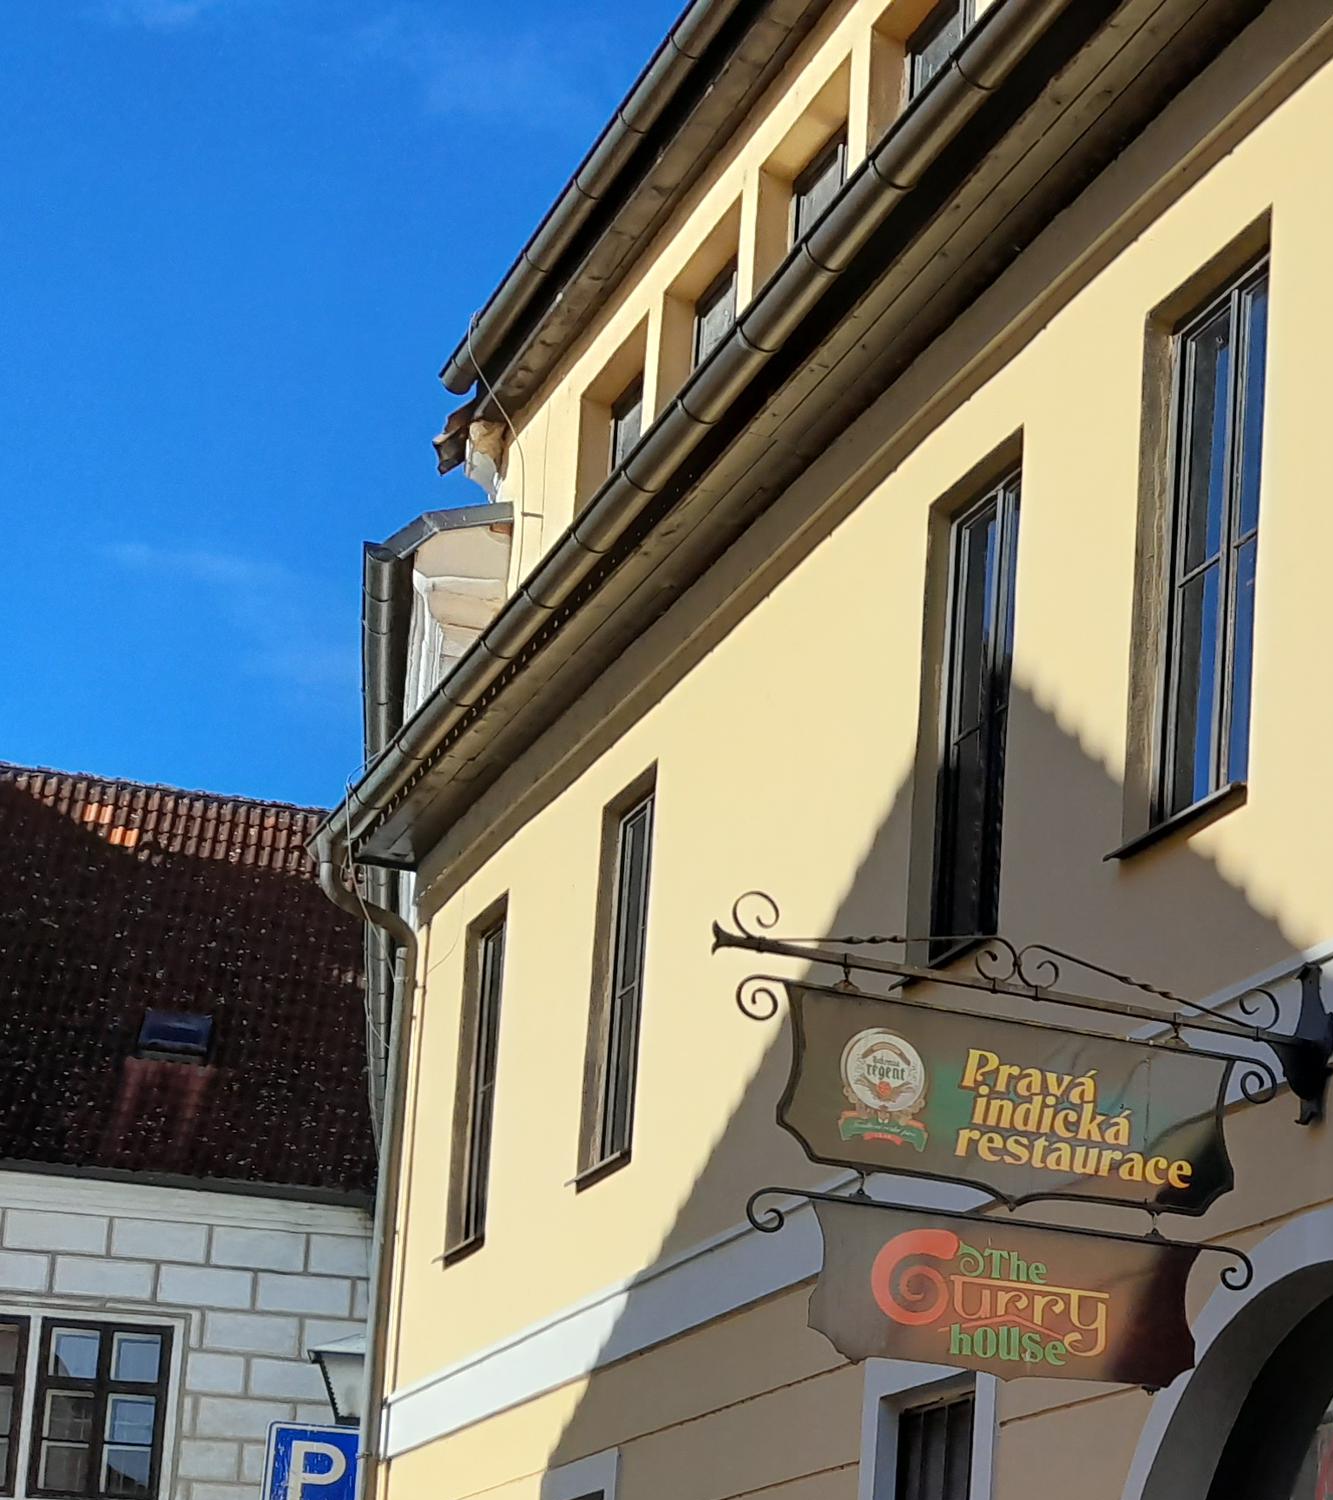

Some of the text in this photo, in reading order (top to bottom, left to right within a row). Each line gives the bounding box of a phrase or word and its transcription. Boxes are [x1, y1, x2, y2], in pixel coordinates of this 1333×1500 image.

[961, 1047, 1098, 1104] Pravá
[971, 1086, 1132, 1147] indická
[953, 1126, 1194, 1190] restaurace
[870, 1228, 1111, 1358] Curry
[984, 1246, 1048, 1285] The
[949, 1322, 1068, 1366] house
